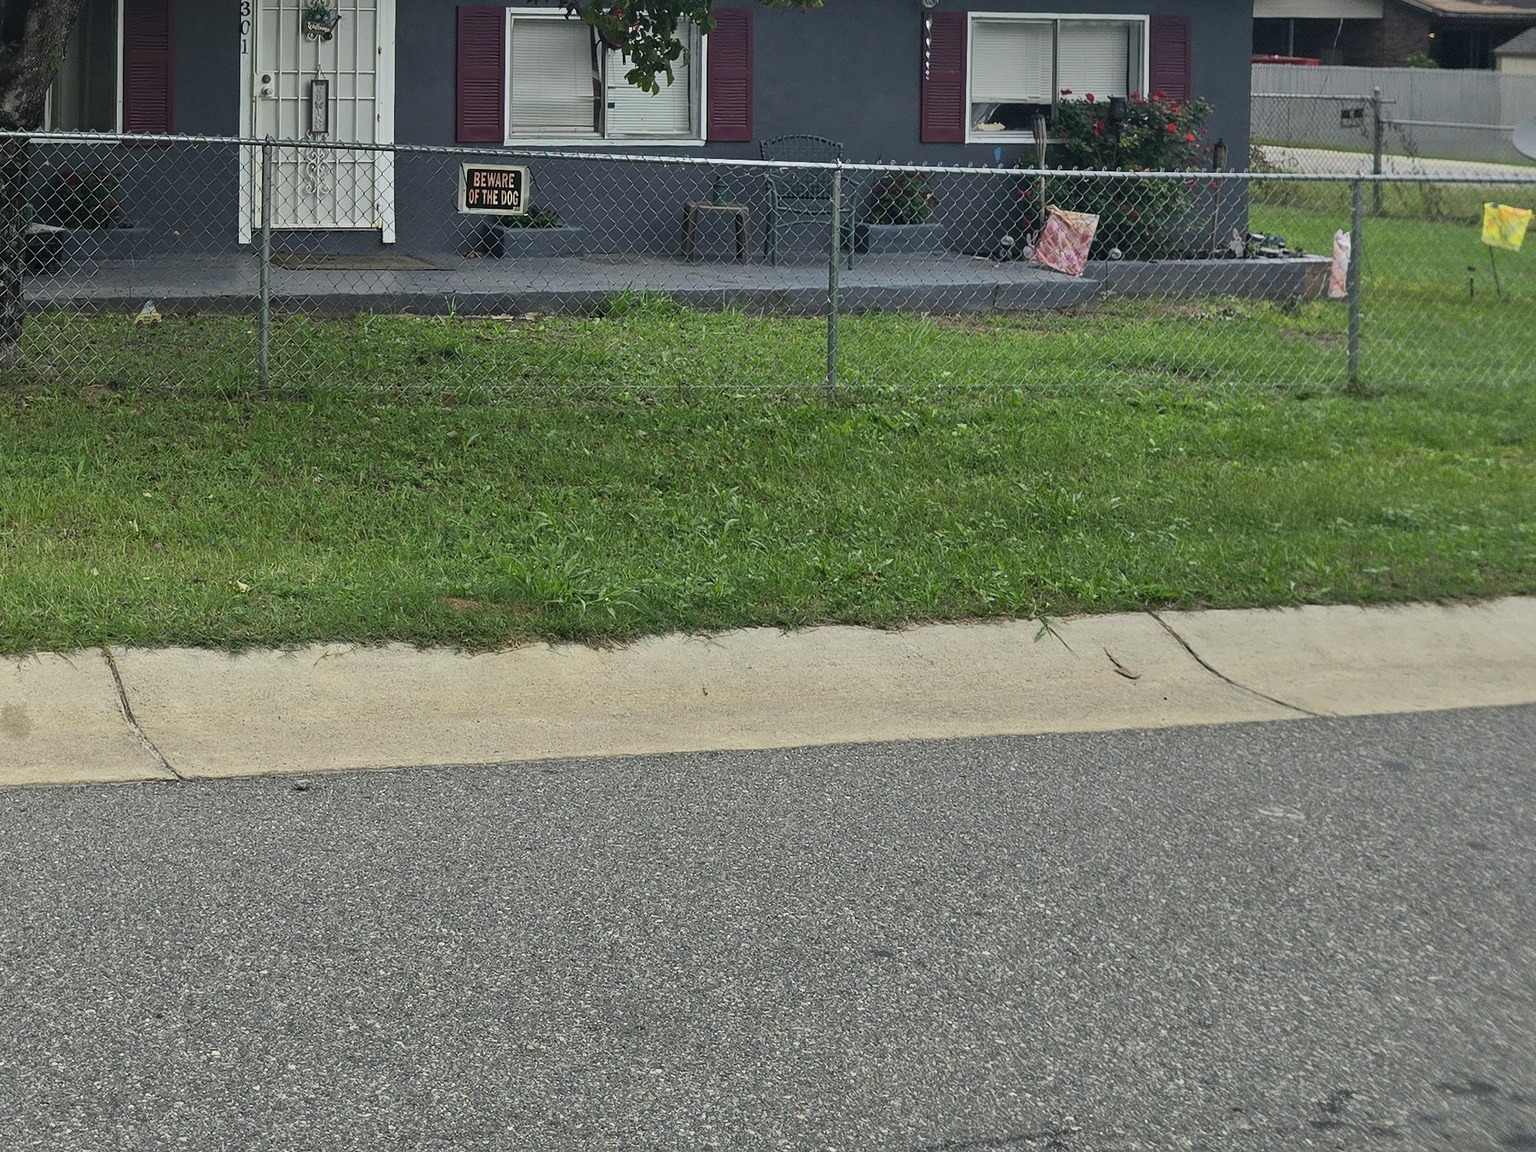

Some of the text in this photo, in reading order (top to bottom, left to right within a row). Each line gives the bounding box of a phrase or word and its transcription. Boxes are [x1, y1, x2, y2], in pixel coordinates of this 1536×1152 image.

[240, 1, 251, 54] 301
[473, 171, 515, 188] BEWARE
[468, 188, 519, 206] OF THE DOG
